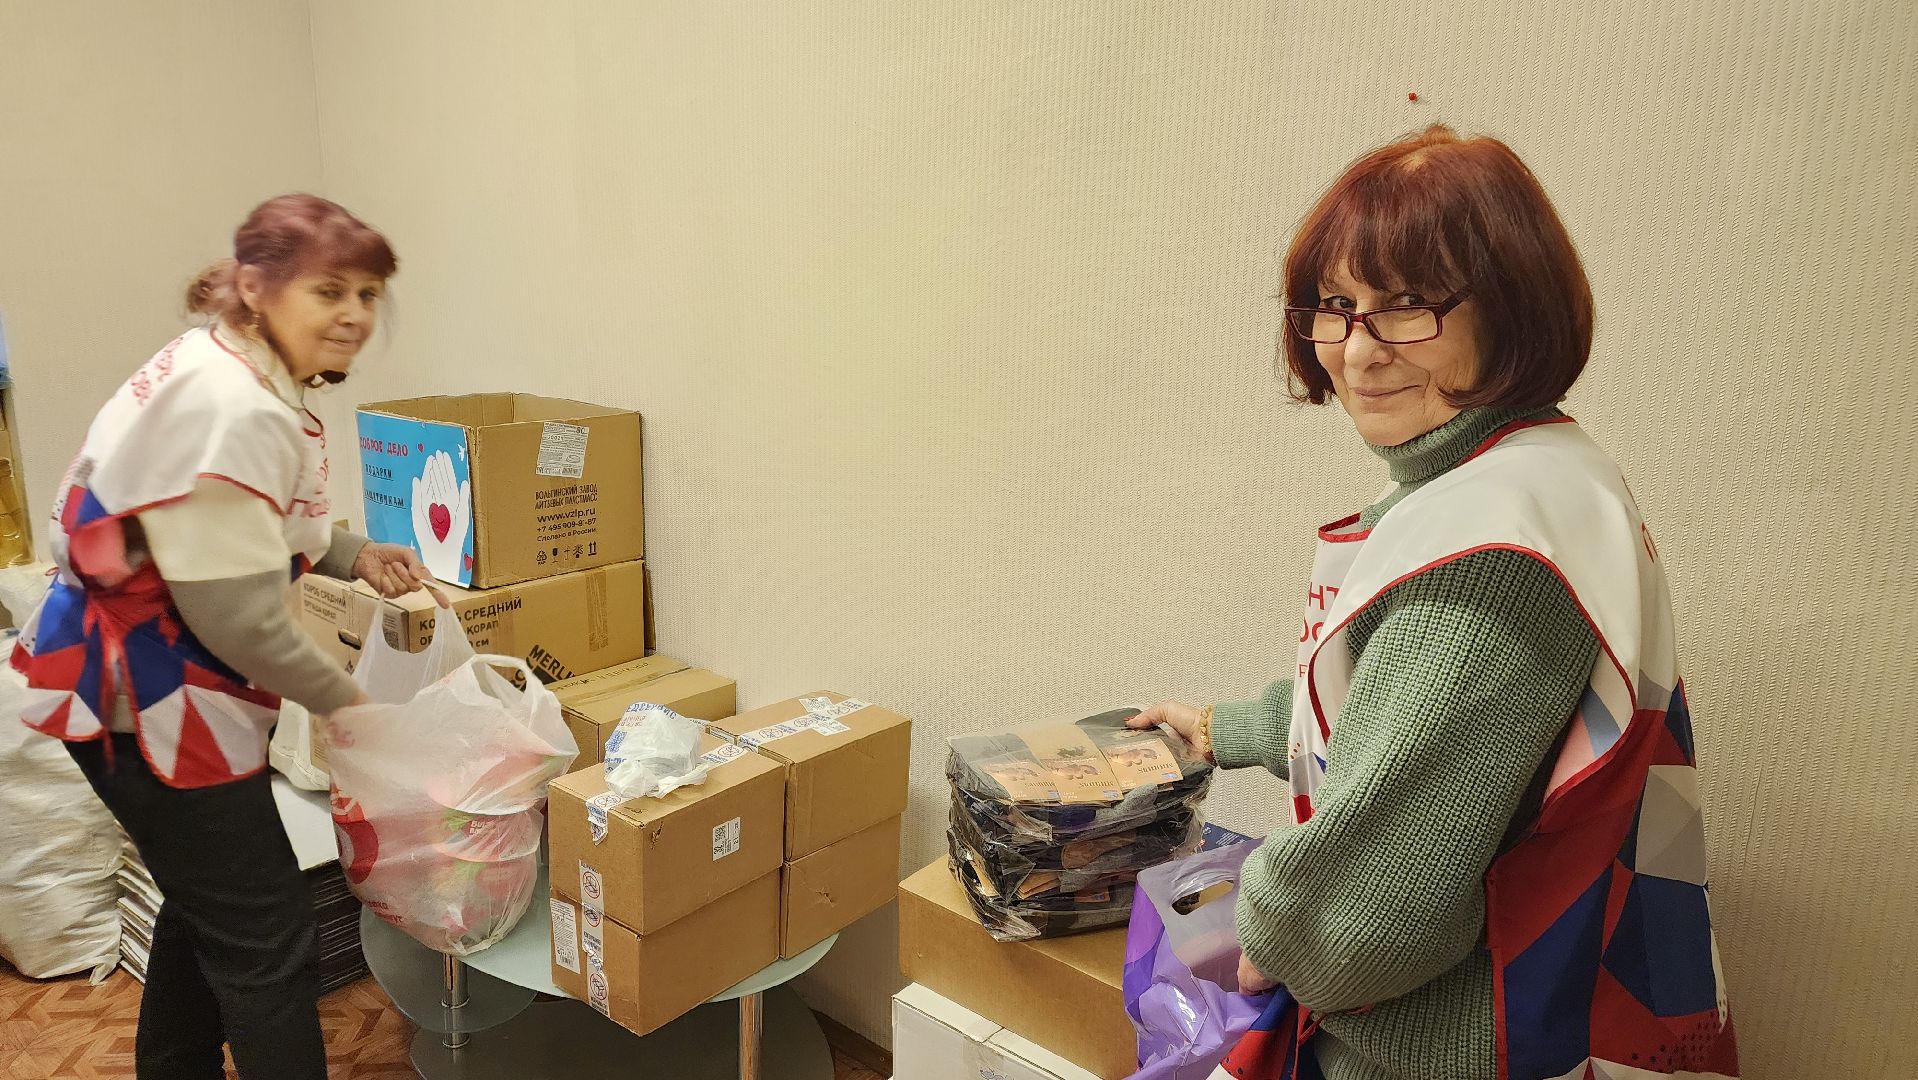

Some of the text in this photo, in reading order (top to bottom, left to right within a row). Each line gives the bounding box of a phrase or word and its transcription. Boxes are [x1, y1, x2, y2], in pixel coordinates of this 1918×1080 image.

[386, 441, 408, 457] ДЕЛО
[536, 507, 596, 523] www.vzlp.ru
[464, 596, 522, 621] СРЕДНИЙ
